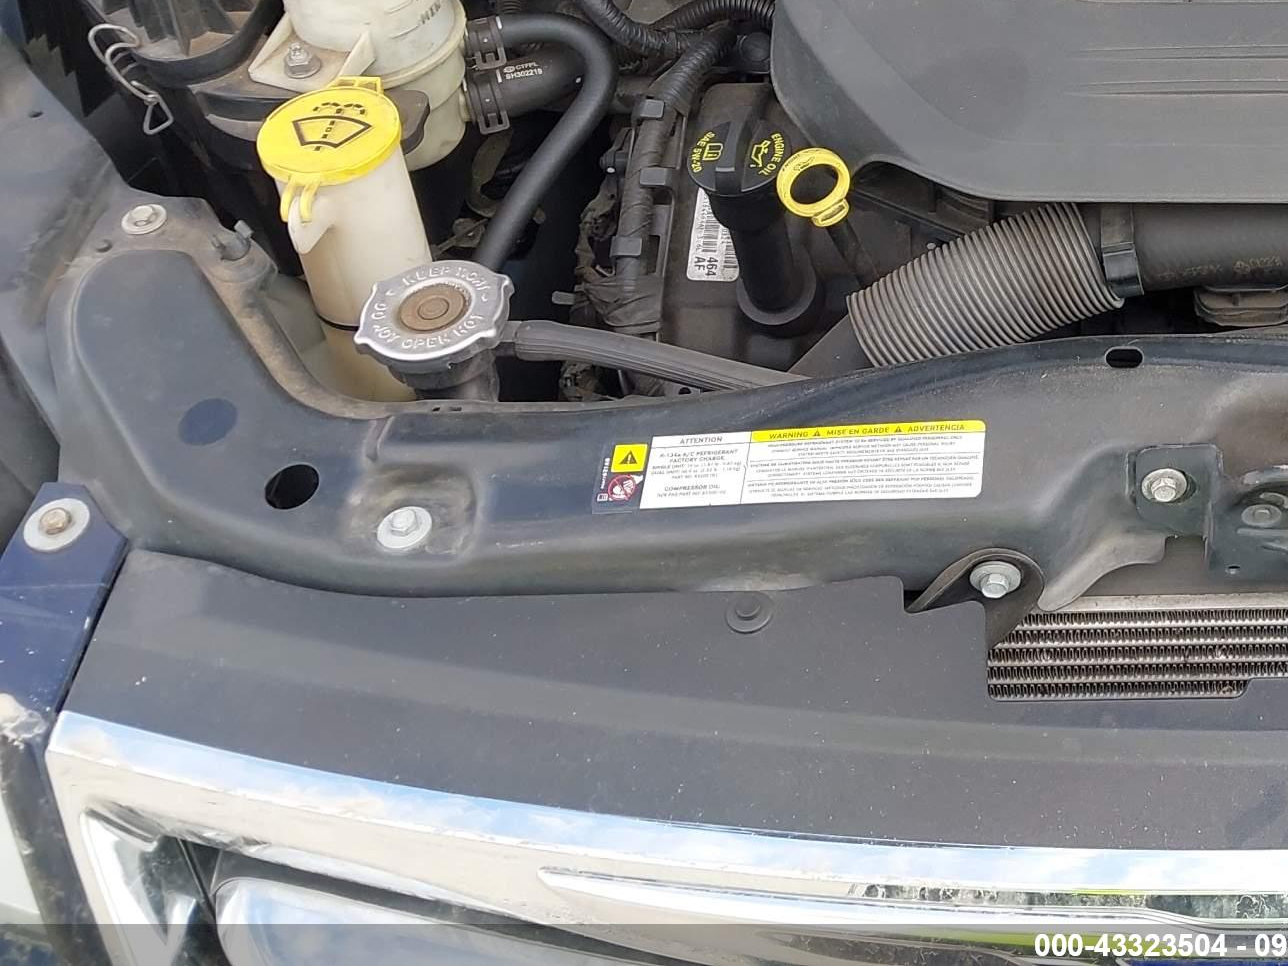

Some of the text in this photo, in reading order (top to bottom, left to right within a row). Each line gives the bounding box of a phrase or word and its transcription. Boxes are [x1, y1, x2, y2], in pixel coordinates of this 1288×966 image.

[420, 0, 441, 25] MIN
[691, 131, 716, 173] SAE 5W-20
[758, 132, 785, 176] ENGINE OIL
[694, 255, 706, 271] AF
[705, 256, 719, 276] 464
[402, 266, 450, 286] KEEP
[401, 334, 451, 349] OPEN
[453, 315, 484, 337] HOT
[680, 436, 723, 445] ATTENTION
